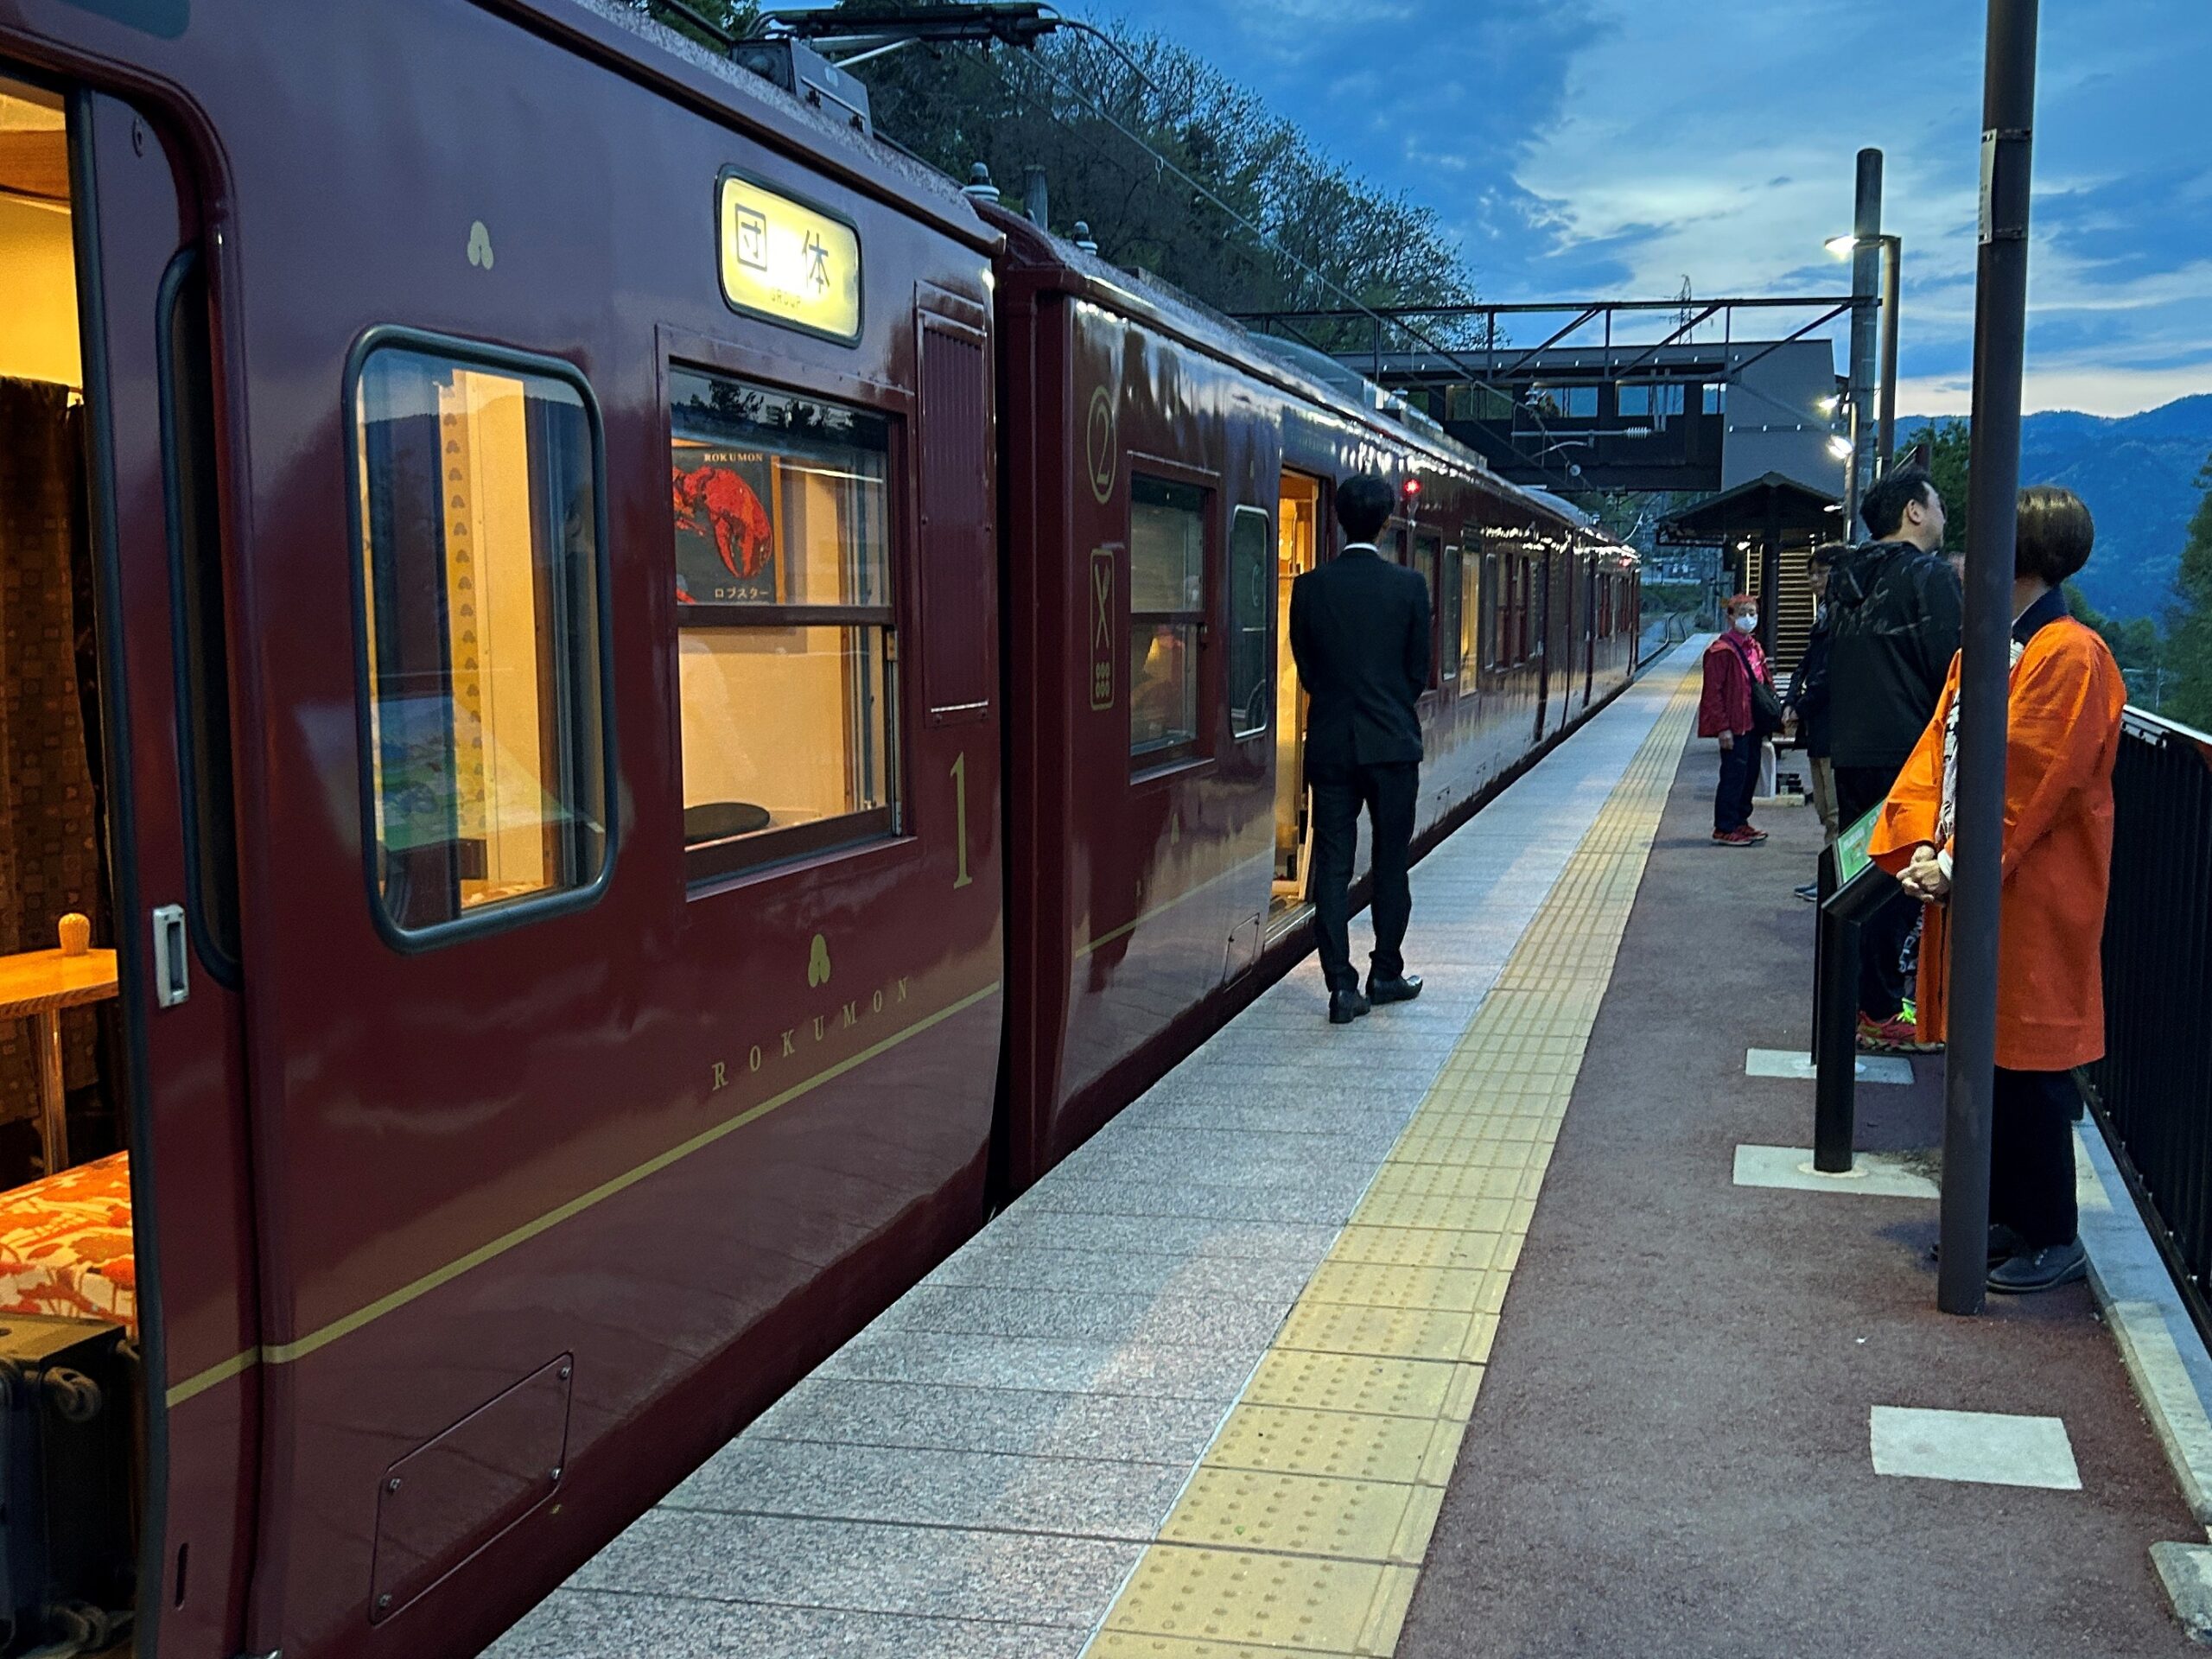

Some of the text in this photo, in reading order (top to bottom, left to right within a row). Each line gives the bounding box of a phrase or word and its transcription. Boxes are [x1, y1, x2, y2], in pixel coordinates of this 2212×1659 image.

[734, 202, 830, 294] 団体
[703, 452, 764, 463] ROKUMON
[1095, 402, 1111, 486] 2
[715, 586, 769, 601] ロブスター
[950, 750, 973, 891] 1
[712, 976, 910, 1092] ROKUMON
